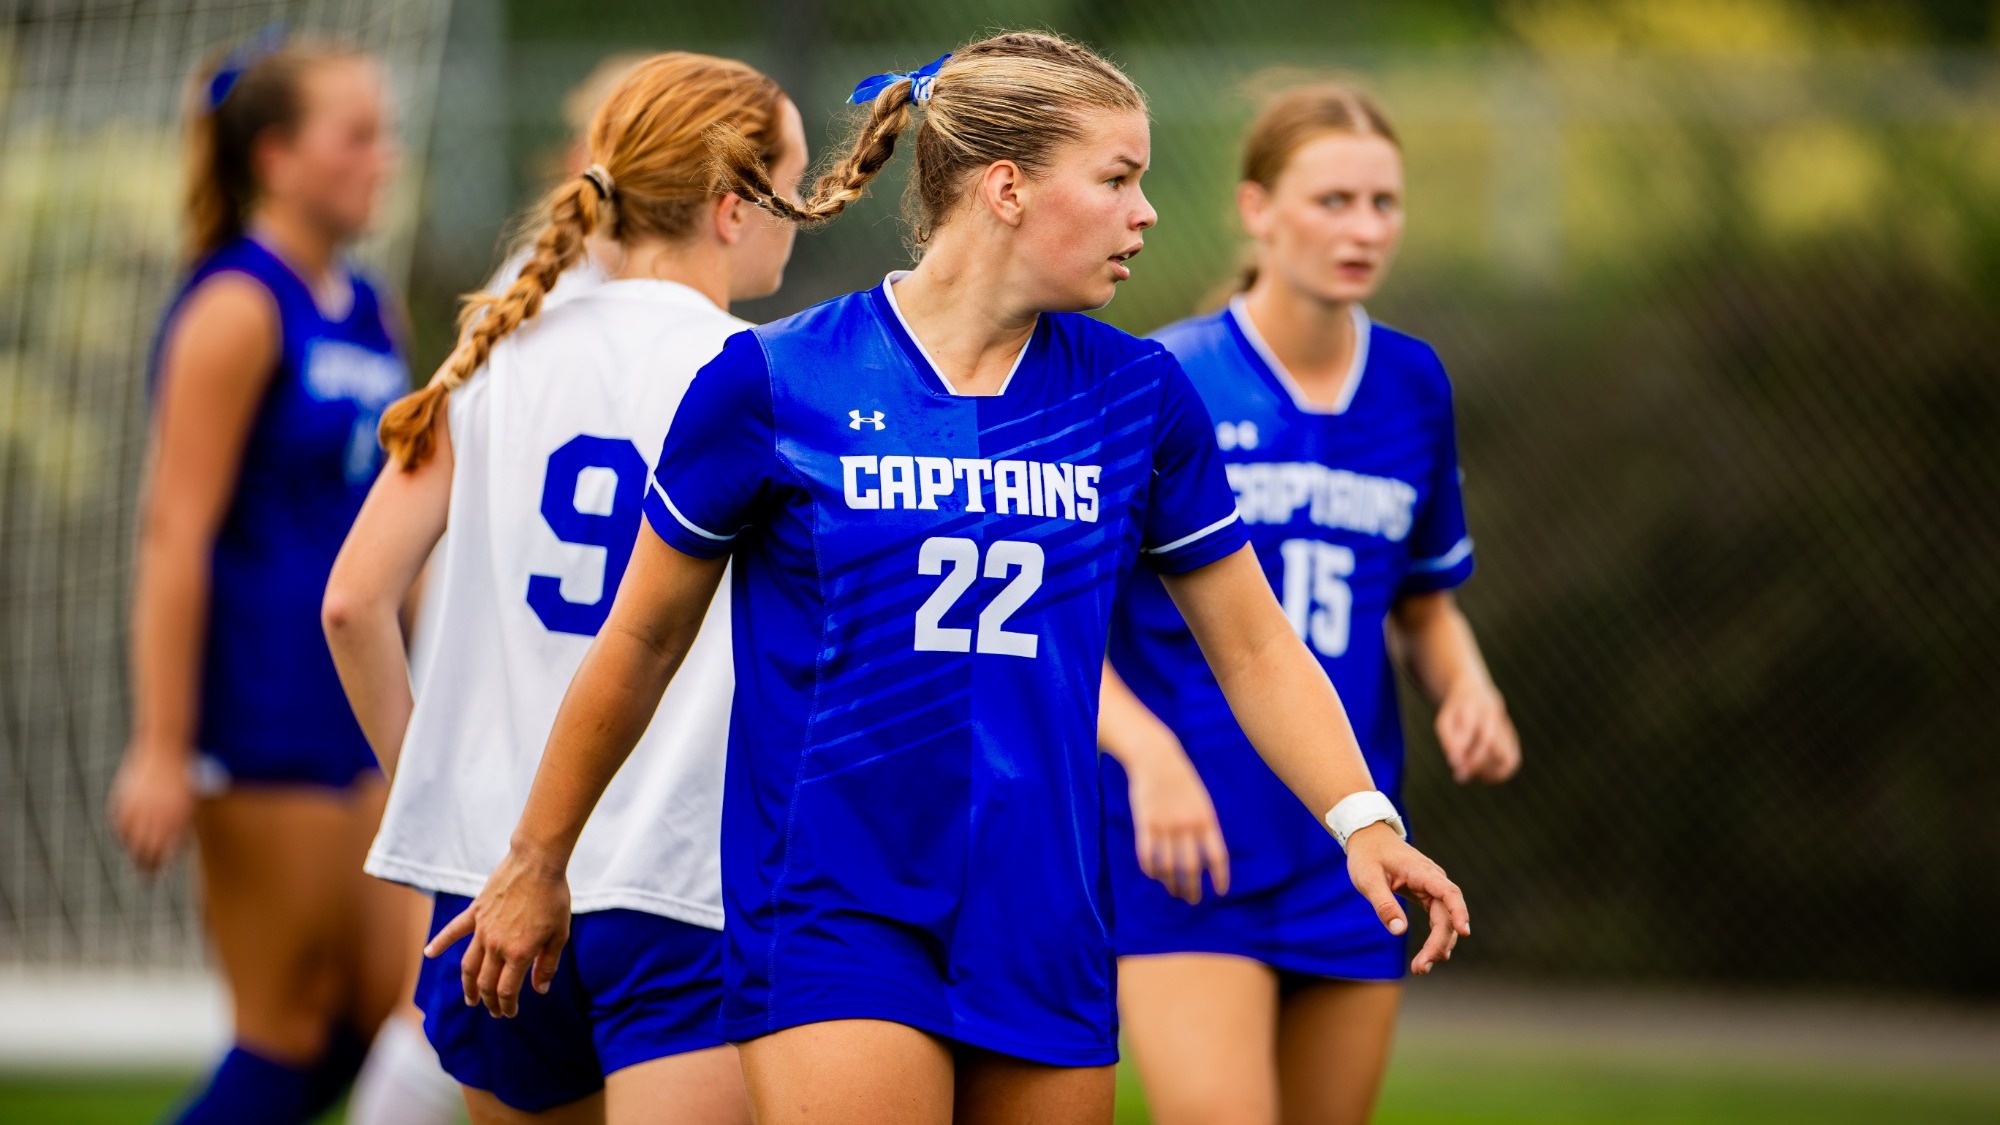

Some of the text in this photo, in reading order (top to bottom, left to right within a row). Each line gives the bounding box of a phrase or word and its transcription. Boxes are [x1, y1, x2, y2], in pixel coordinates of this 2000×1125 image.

[526, 434, 649, 637] 9
[839, 454, 1102, 523] CAPTAINS
[914, 536, 1045, 658] 22
[1280, 538, 1355, 658] 15
